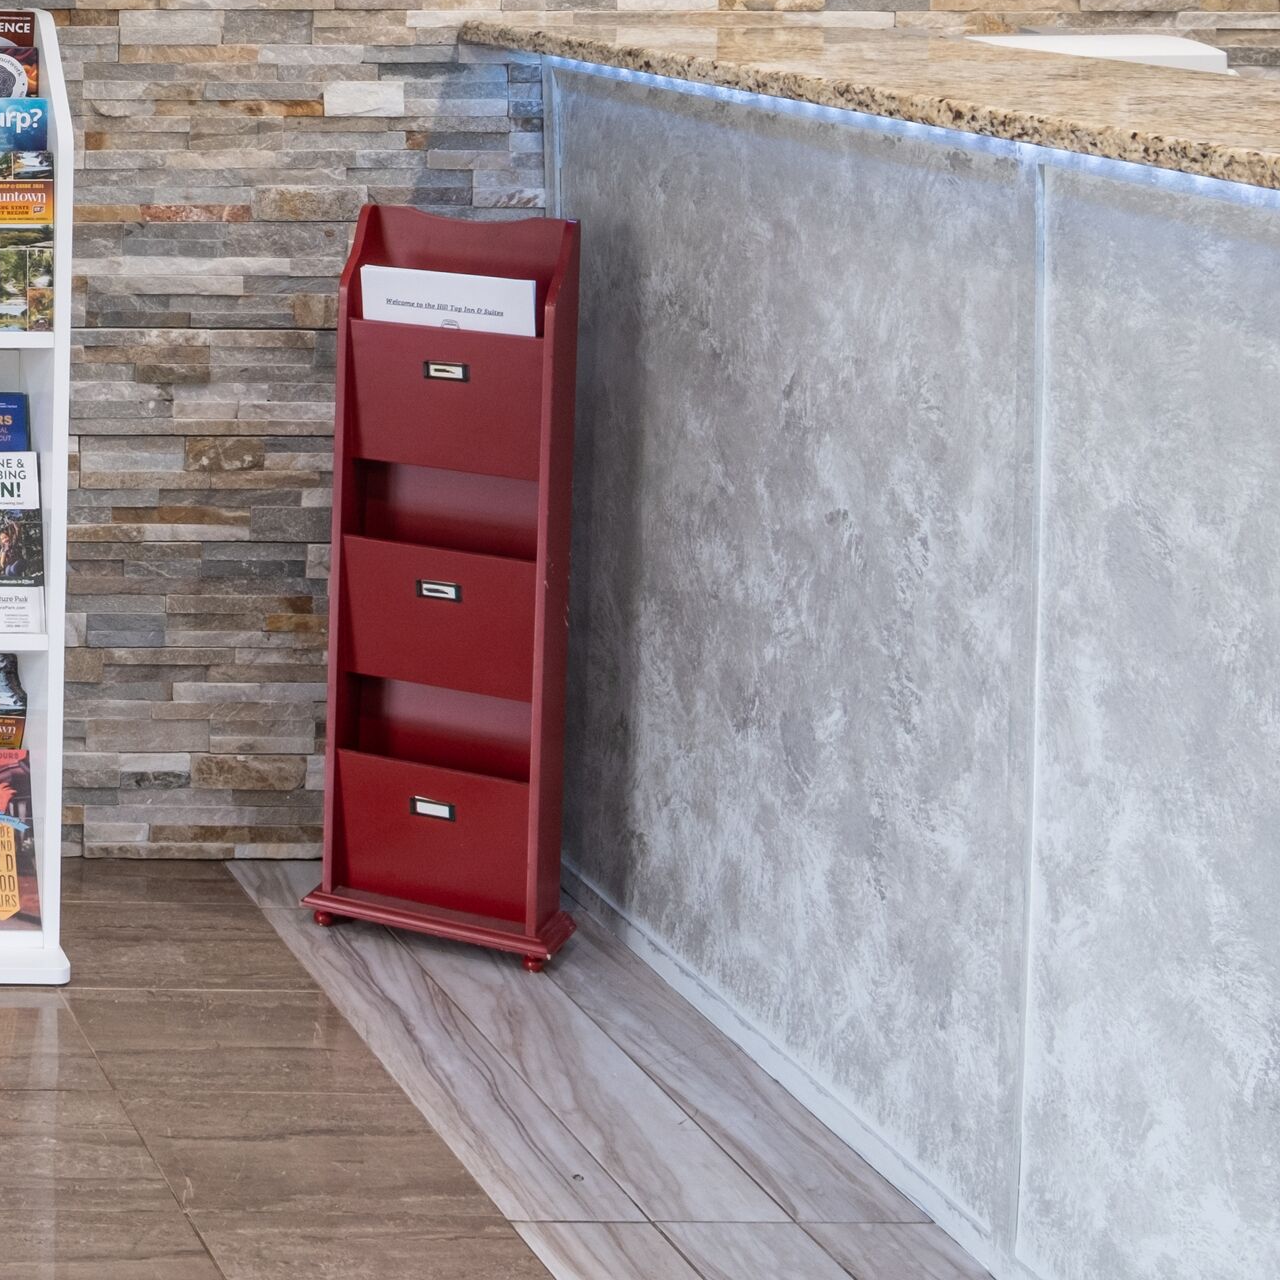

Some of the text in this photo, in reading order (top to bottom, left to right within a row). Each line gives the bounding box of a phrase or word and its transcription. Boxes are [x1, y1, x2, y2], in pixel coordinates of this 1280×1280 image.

[386, 298, 415, 307] Welcome
[450, 304, 462, 313] Top
[484, 308, 503, 316] Suites
[17, 459, 24, 468] &
